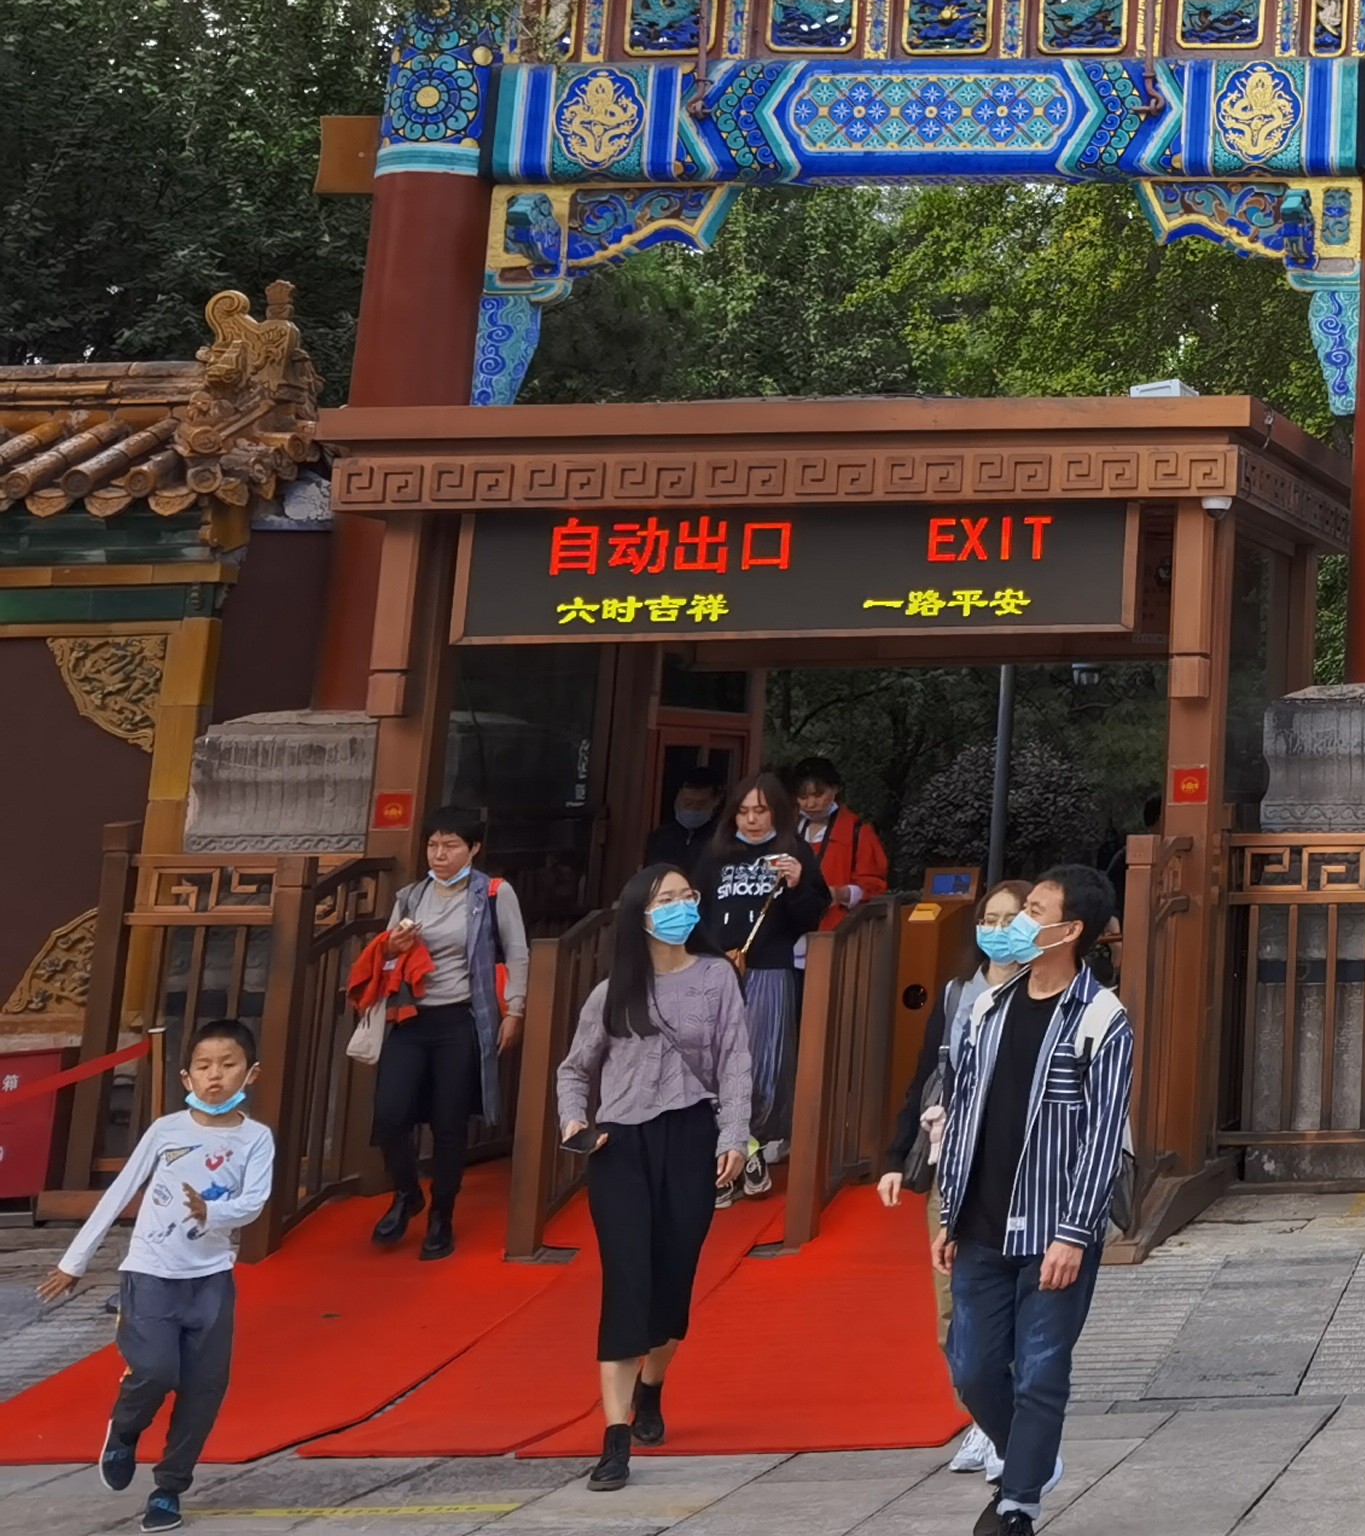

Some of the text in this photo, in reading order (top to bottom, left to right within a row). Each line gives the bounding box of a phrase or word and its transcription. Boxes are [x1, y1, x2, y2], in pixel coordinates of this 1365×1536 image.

[548, 516, 1053, 576] 自动出口 EXIT
[556, 589, 1031, 624] 六时吉祥 一路平安
